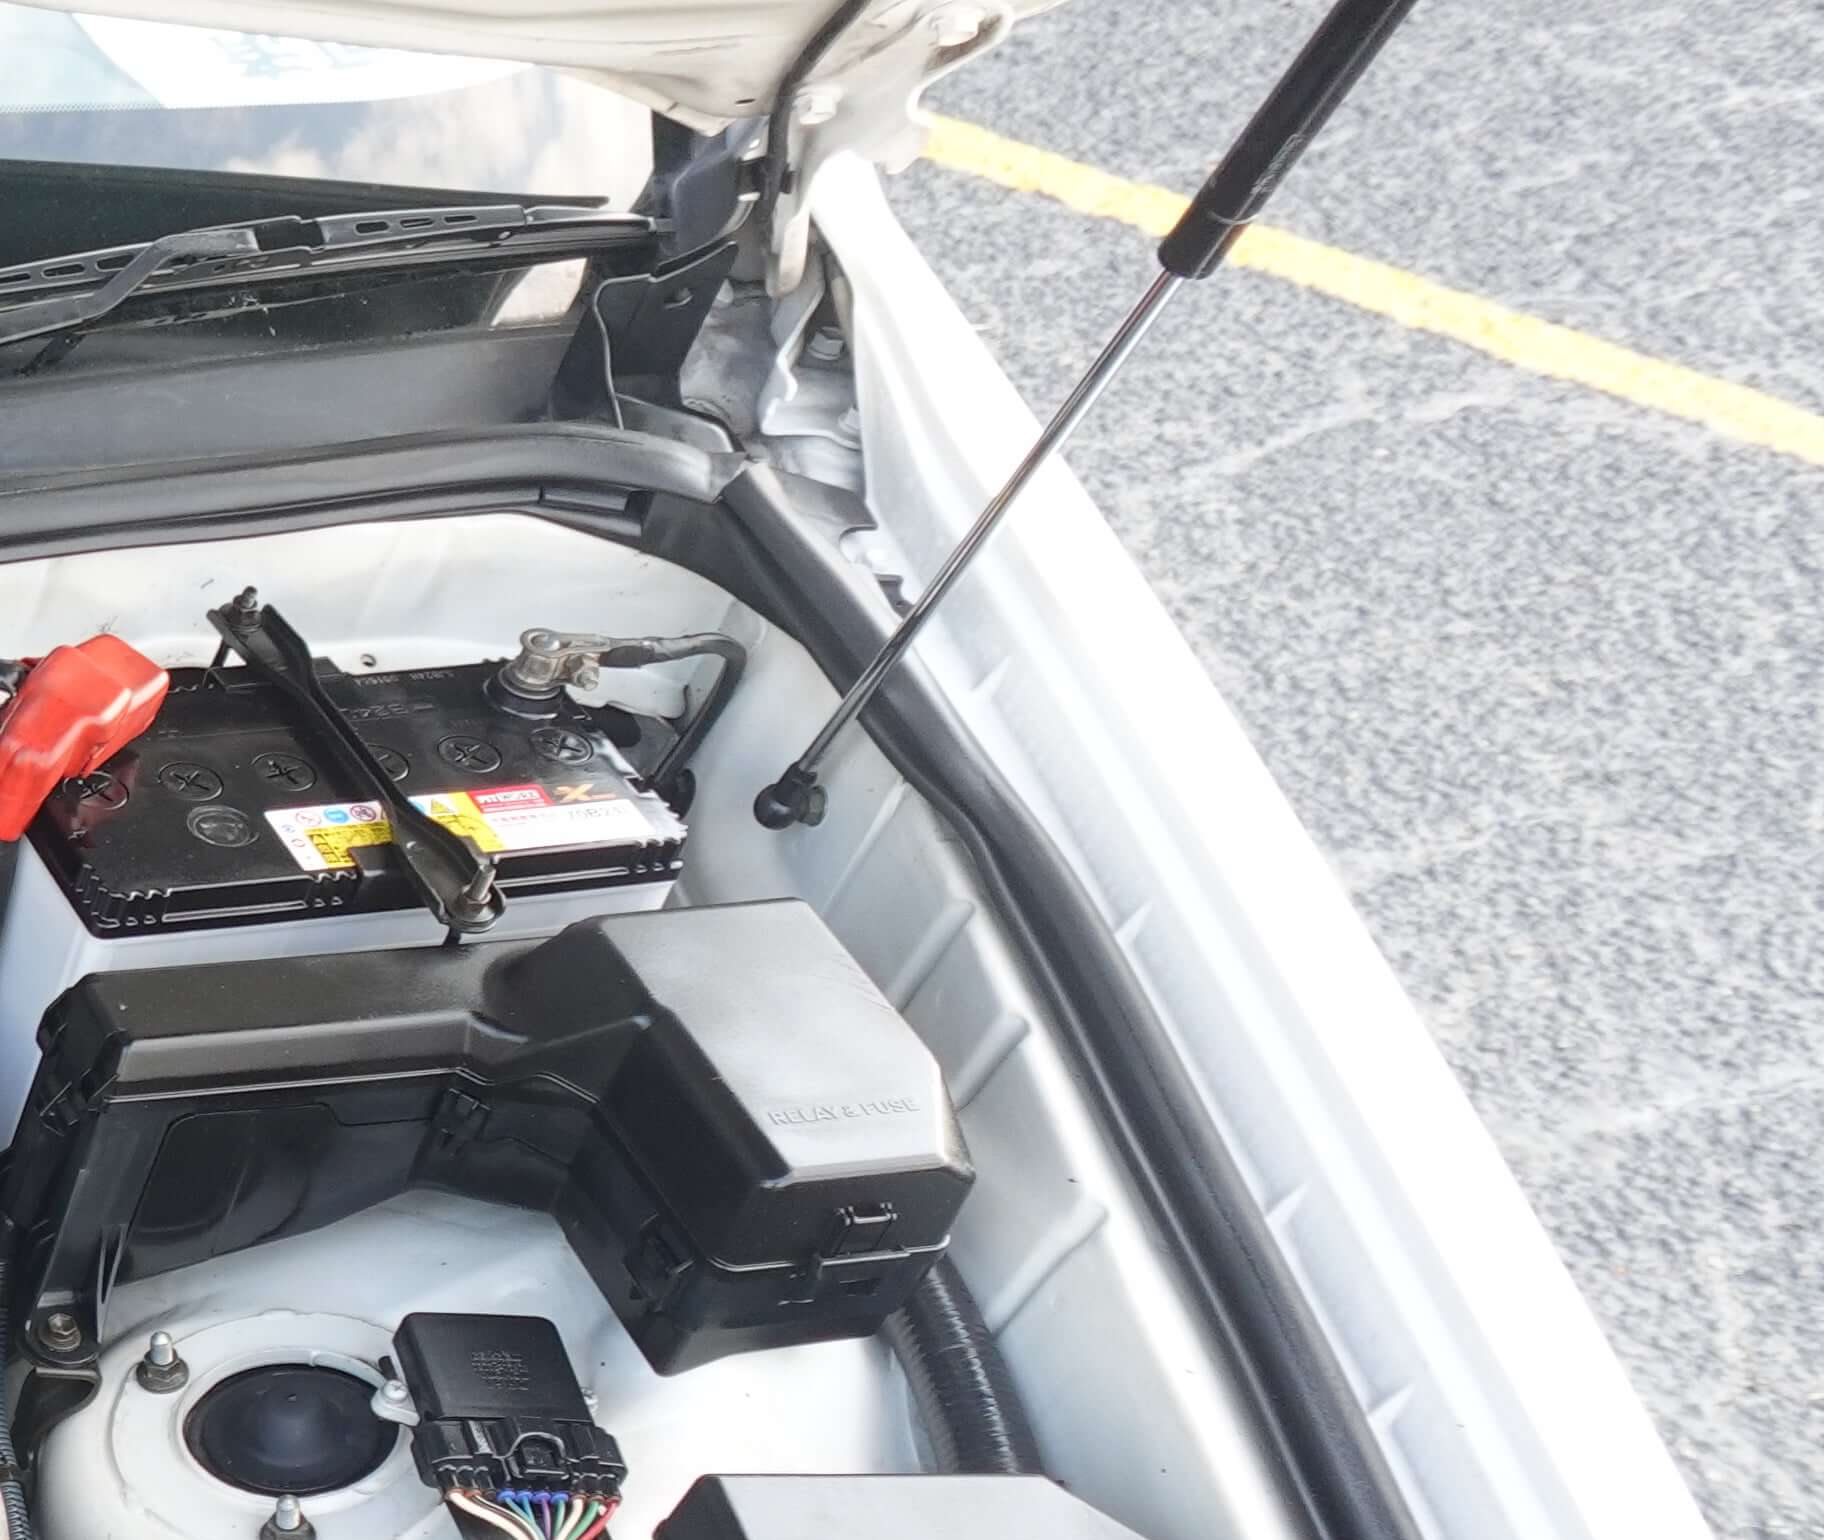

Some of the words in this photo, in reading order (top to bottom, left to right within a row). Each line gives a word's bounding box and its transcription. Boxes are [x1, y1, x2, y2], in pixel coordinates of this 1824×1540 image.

[768, 1106, 838, 1126] RELAY
[840, 1105, 861, 1118] &
[859, 1097, 921, 1117] FUSE
